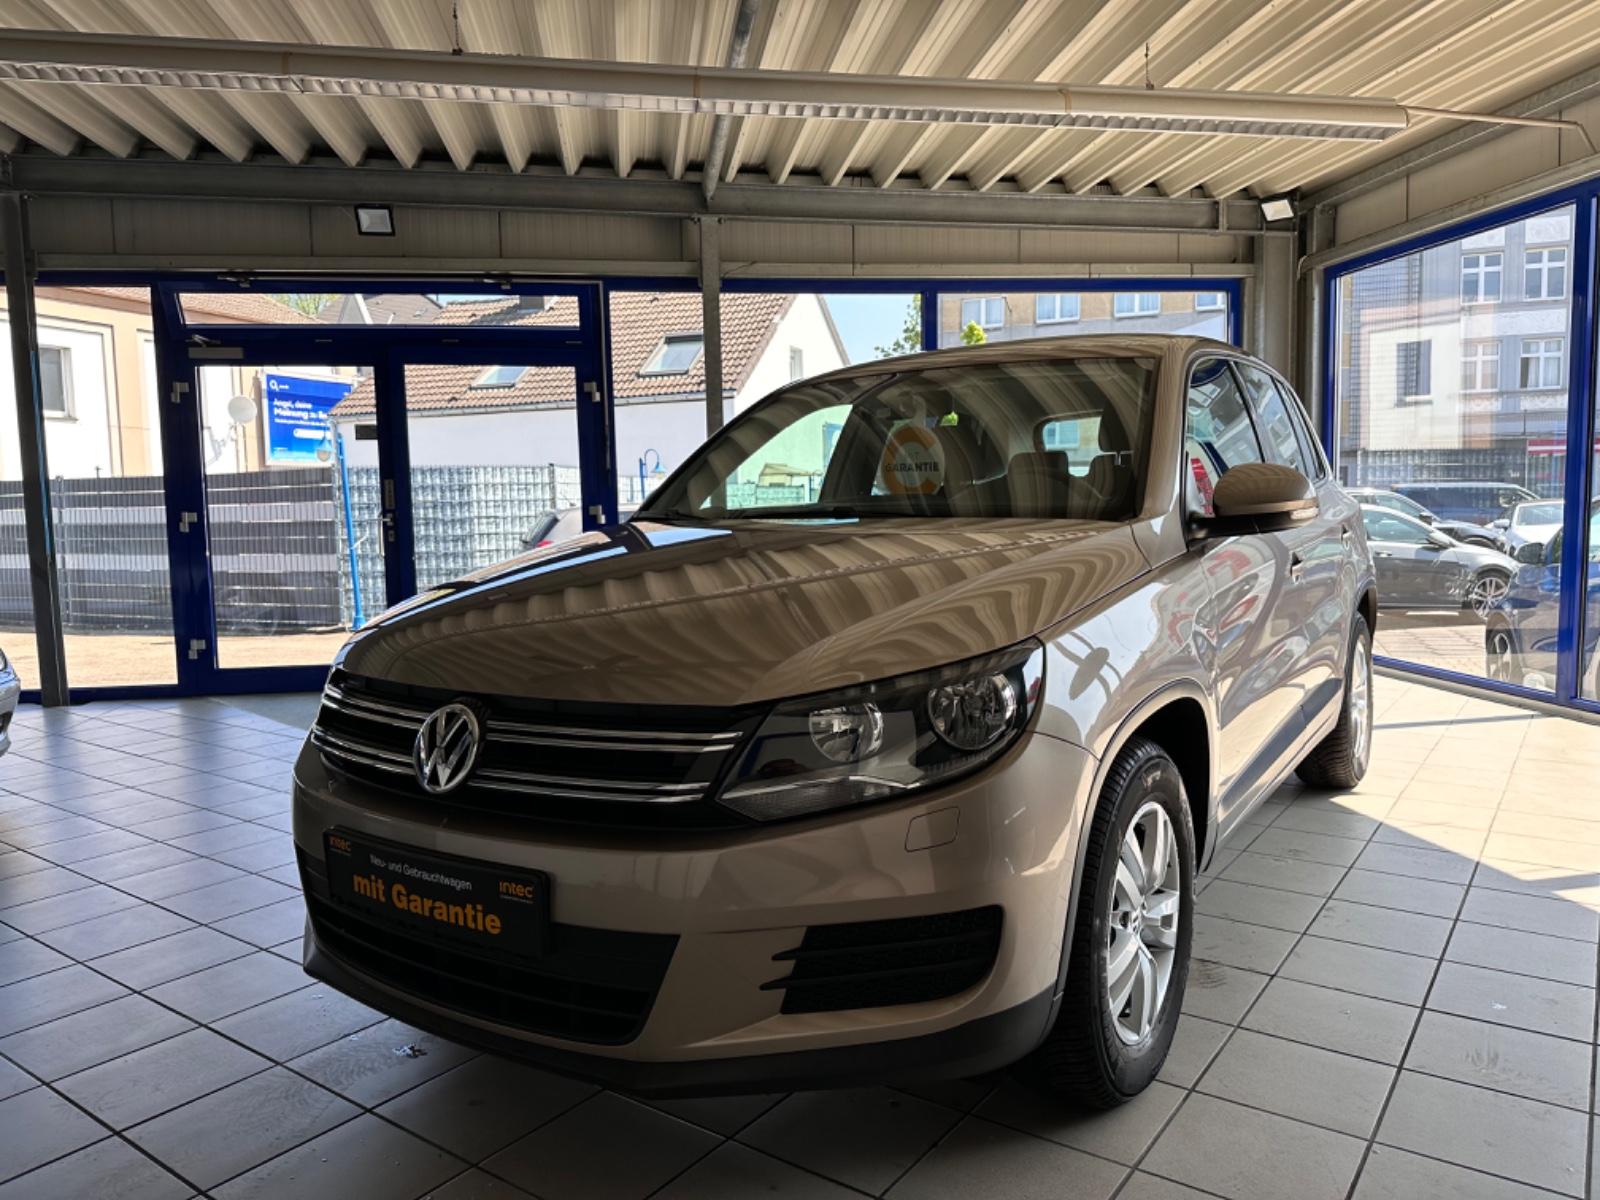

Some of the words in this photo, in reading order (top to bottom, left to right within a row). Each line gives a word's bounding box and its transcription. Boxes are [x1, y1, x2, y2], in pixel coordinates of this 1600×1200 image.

[885, 461, 940, 473] GARANTIE
[369, 854, 387, 868] Neu-
[388, 860, 402, 873] und
[403, 864, 473, 891] Gebrauchtwagen
[499, 880, 534, 899] intec
[352, 873, 386, 903] mit
[391, 883, 502, 935] Garantie
